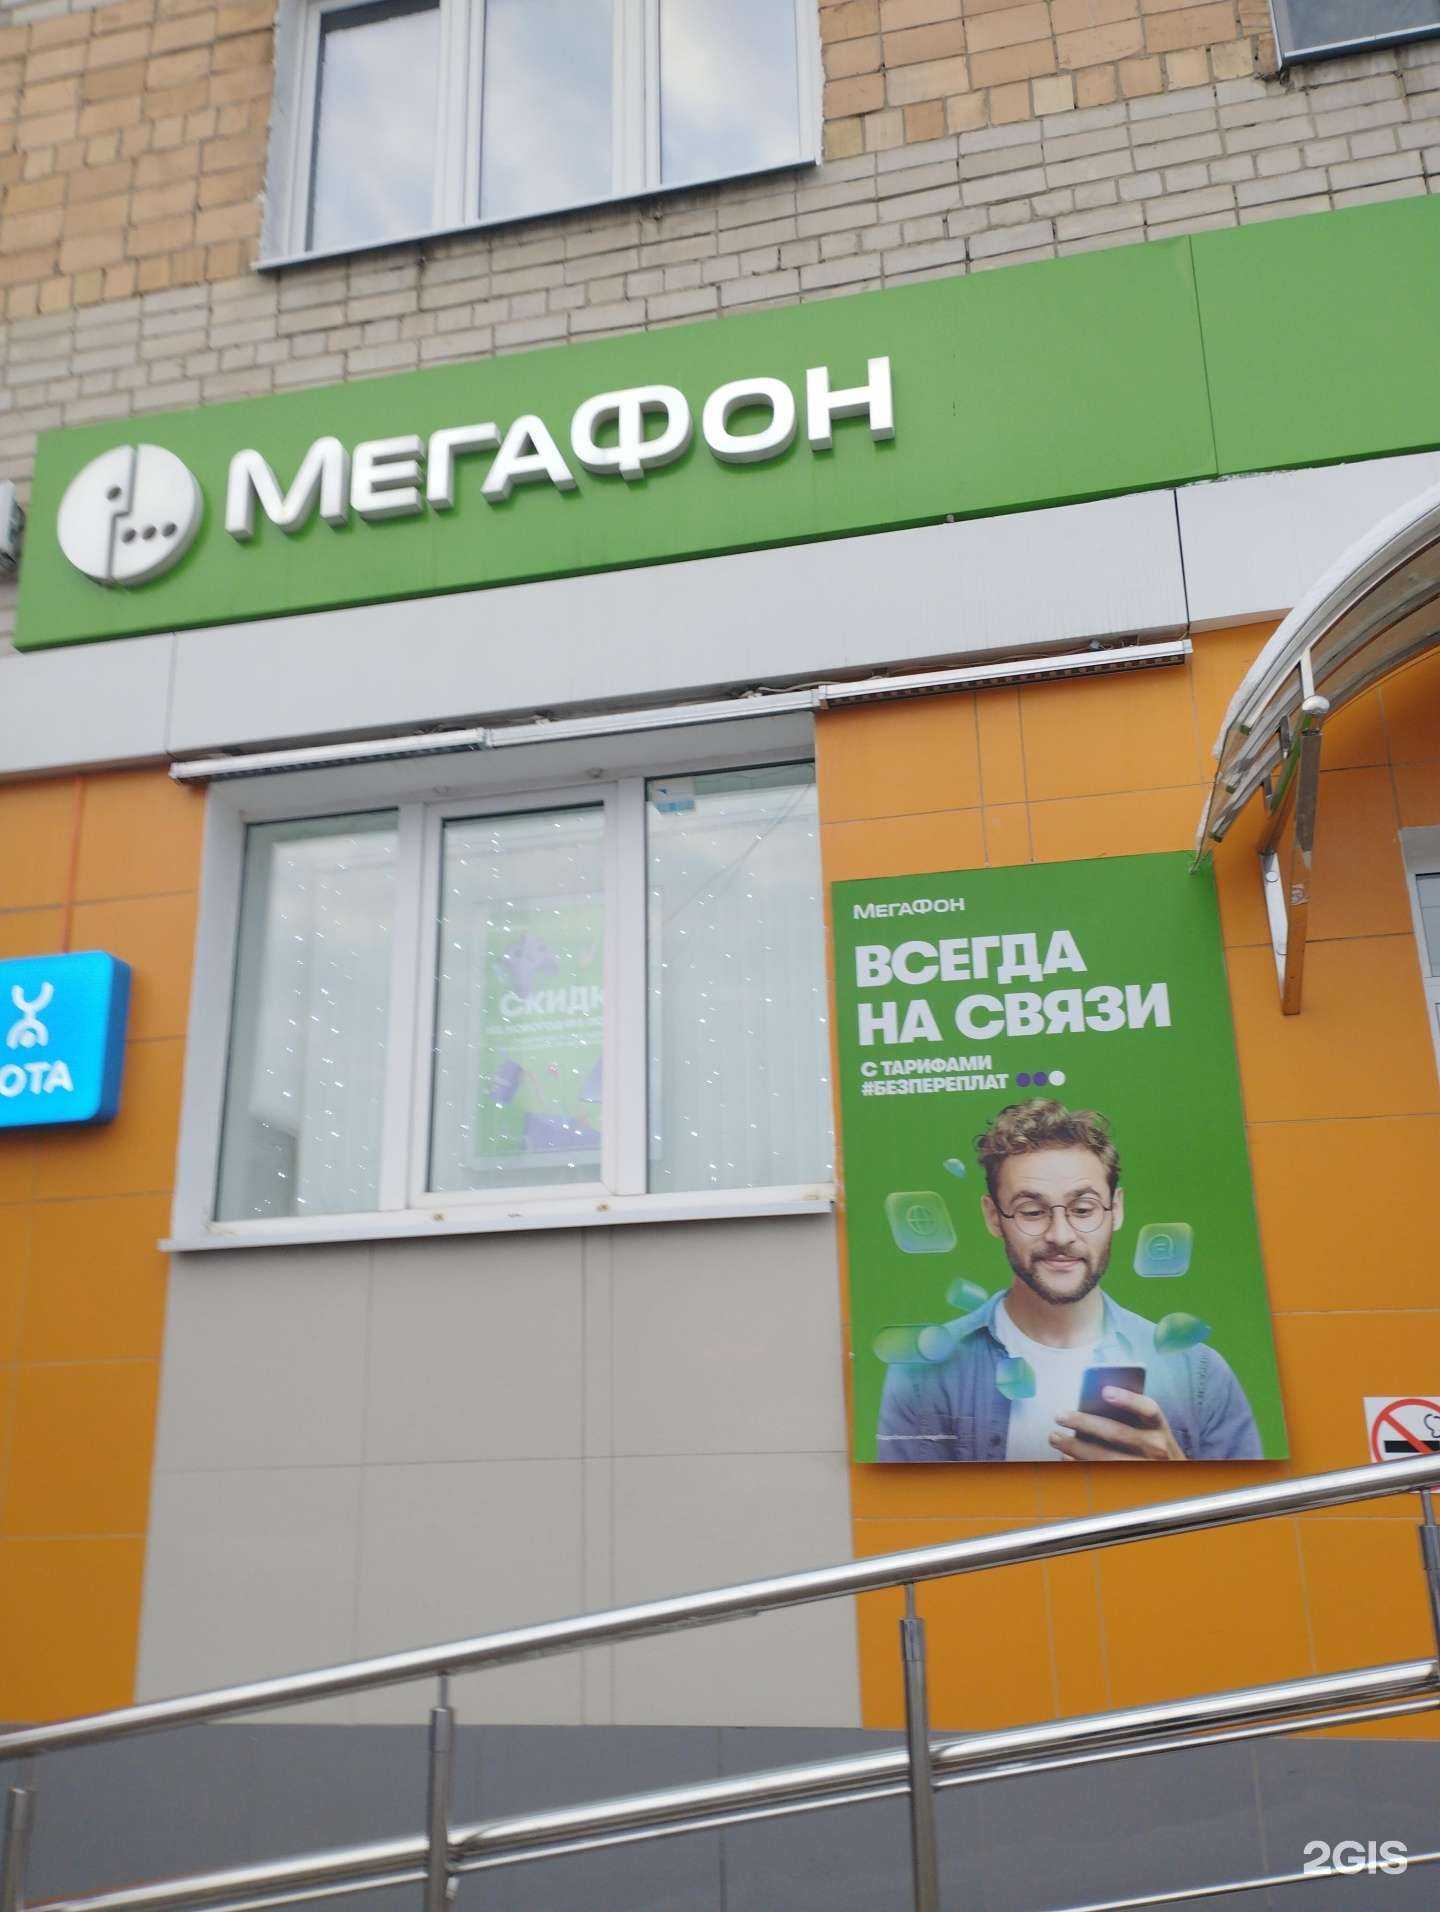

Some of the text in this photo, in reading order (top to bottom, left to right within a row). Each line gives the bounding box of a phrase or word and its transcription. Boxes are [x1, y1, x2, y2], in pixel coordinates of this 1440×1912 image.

[854, 930, 1088, 988] ВСЕГДА
[857, 982, 1173, 1047] НА СВЯЗИ
[860, 1054, 993, 1078] С ТАРИФАМИ
[860, 1072, 1010, 1097] #БЕЗПЕРЕПЛАТ
